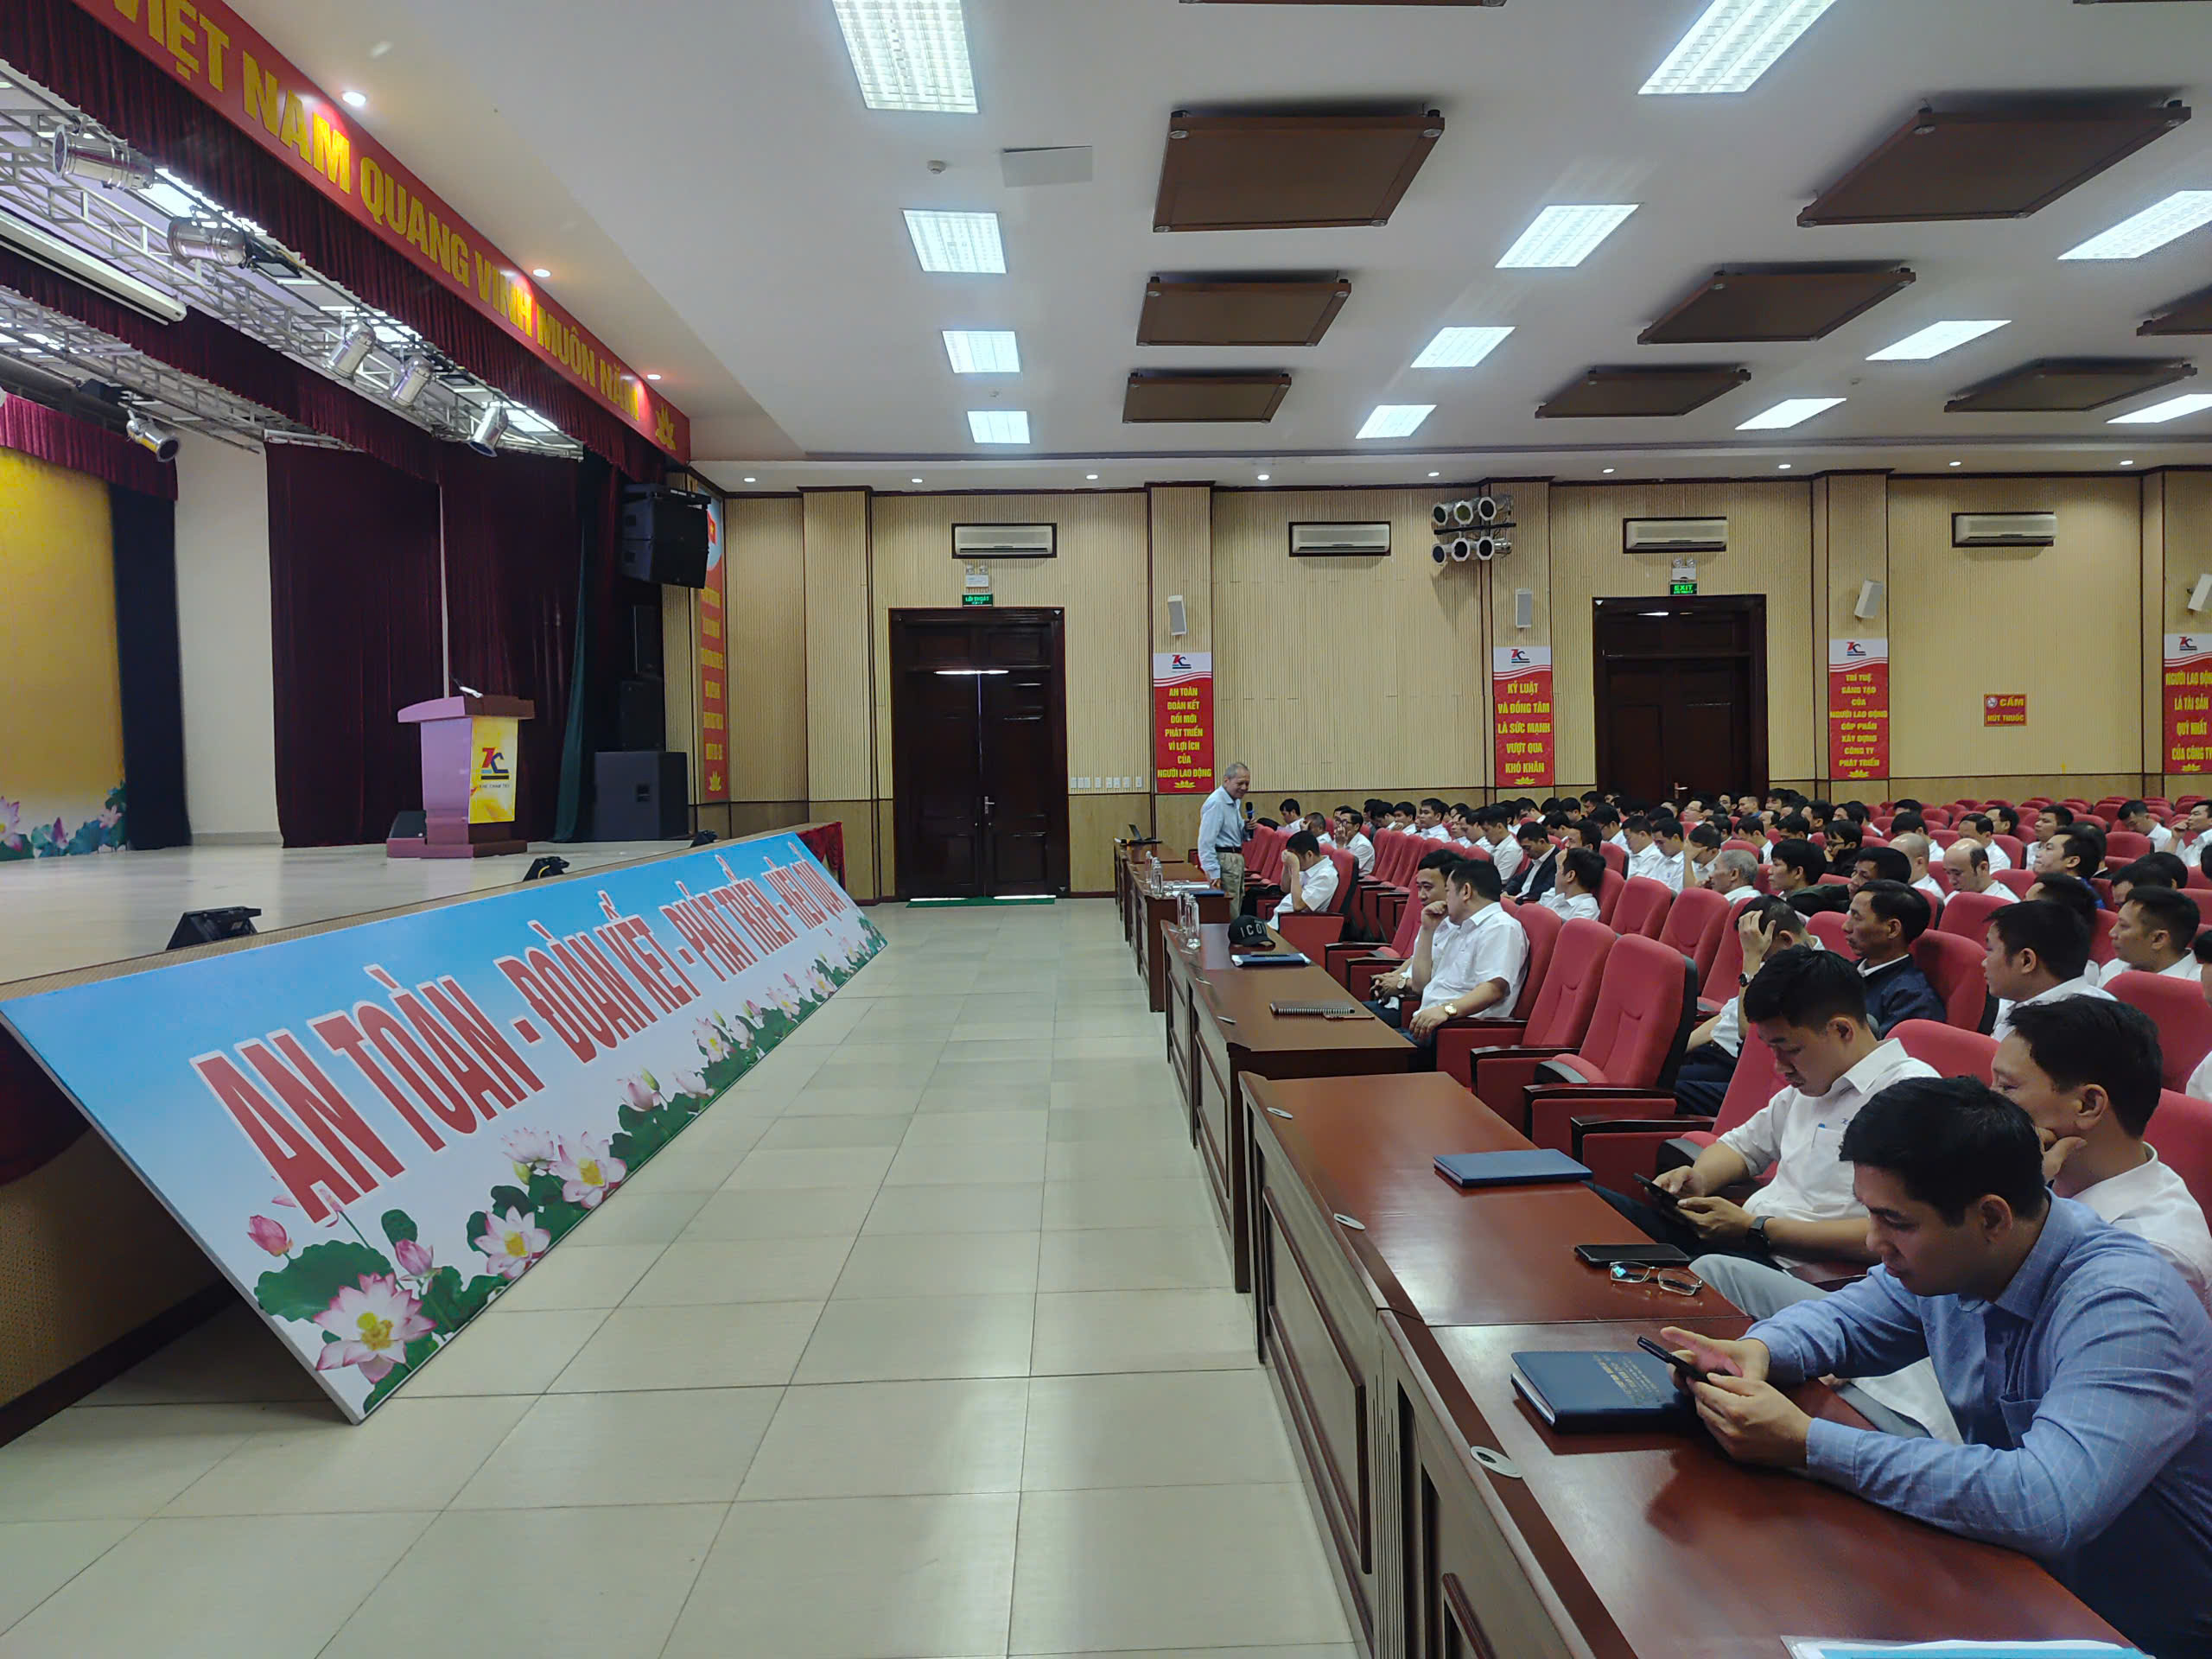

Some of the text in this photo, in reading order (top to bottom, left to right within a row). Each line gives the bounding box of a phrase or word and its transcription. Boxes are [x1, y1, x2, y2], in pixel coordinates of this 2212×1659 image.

[113, 0, 230, 92] IỆT
[243, 49, 350, 194] NAM
[359, 156, 470, 289] QUANG
[474, 249, 532, 337] VINH
[536, 303, 596, 388] MUÔN
[1169, 688, 1179, 696] AN
[1520, 681, 1538, 696] LUẬT
[1187, 699, 1200, 710] KẾT
[1497, 702, 1508, 714] VÀ
[1165, 727, 1182, 737] PHÁT
[1497, 721, 1551, 735] LÀ SỨC MẠNH
[1527, 742, 1543, 753] QUA
[1178, 753, 1191, 764] CỦA
[1505, 761, 1521, 773] KHÓ
[1179, 769, 1192, 778] LAO
[194, 1030, 407, 1224] AN
[309, 966, 546, 1153] TOÀN
[495, 921, 658, 1065] ĐOÀN
[594, 891, 702, 1015] KẾT
[659, 880, 759, 982] PHÁT
[710, 854, 798, 956] TRIỂN
